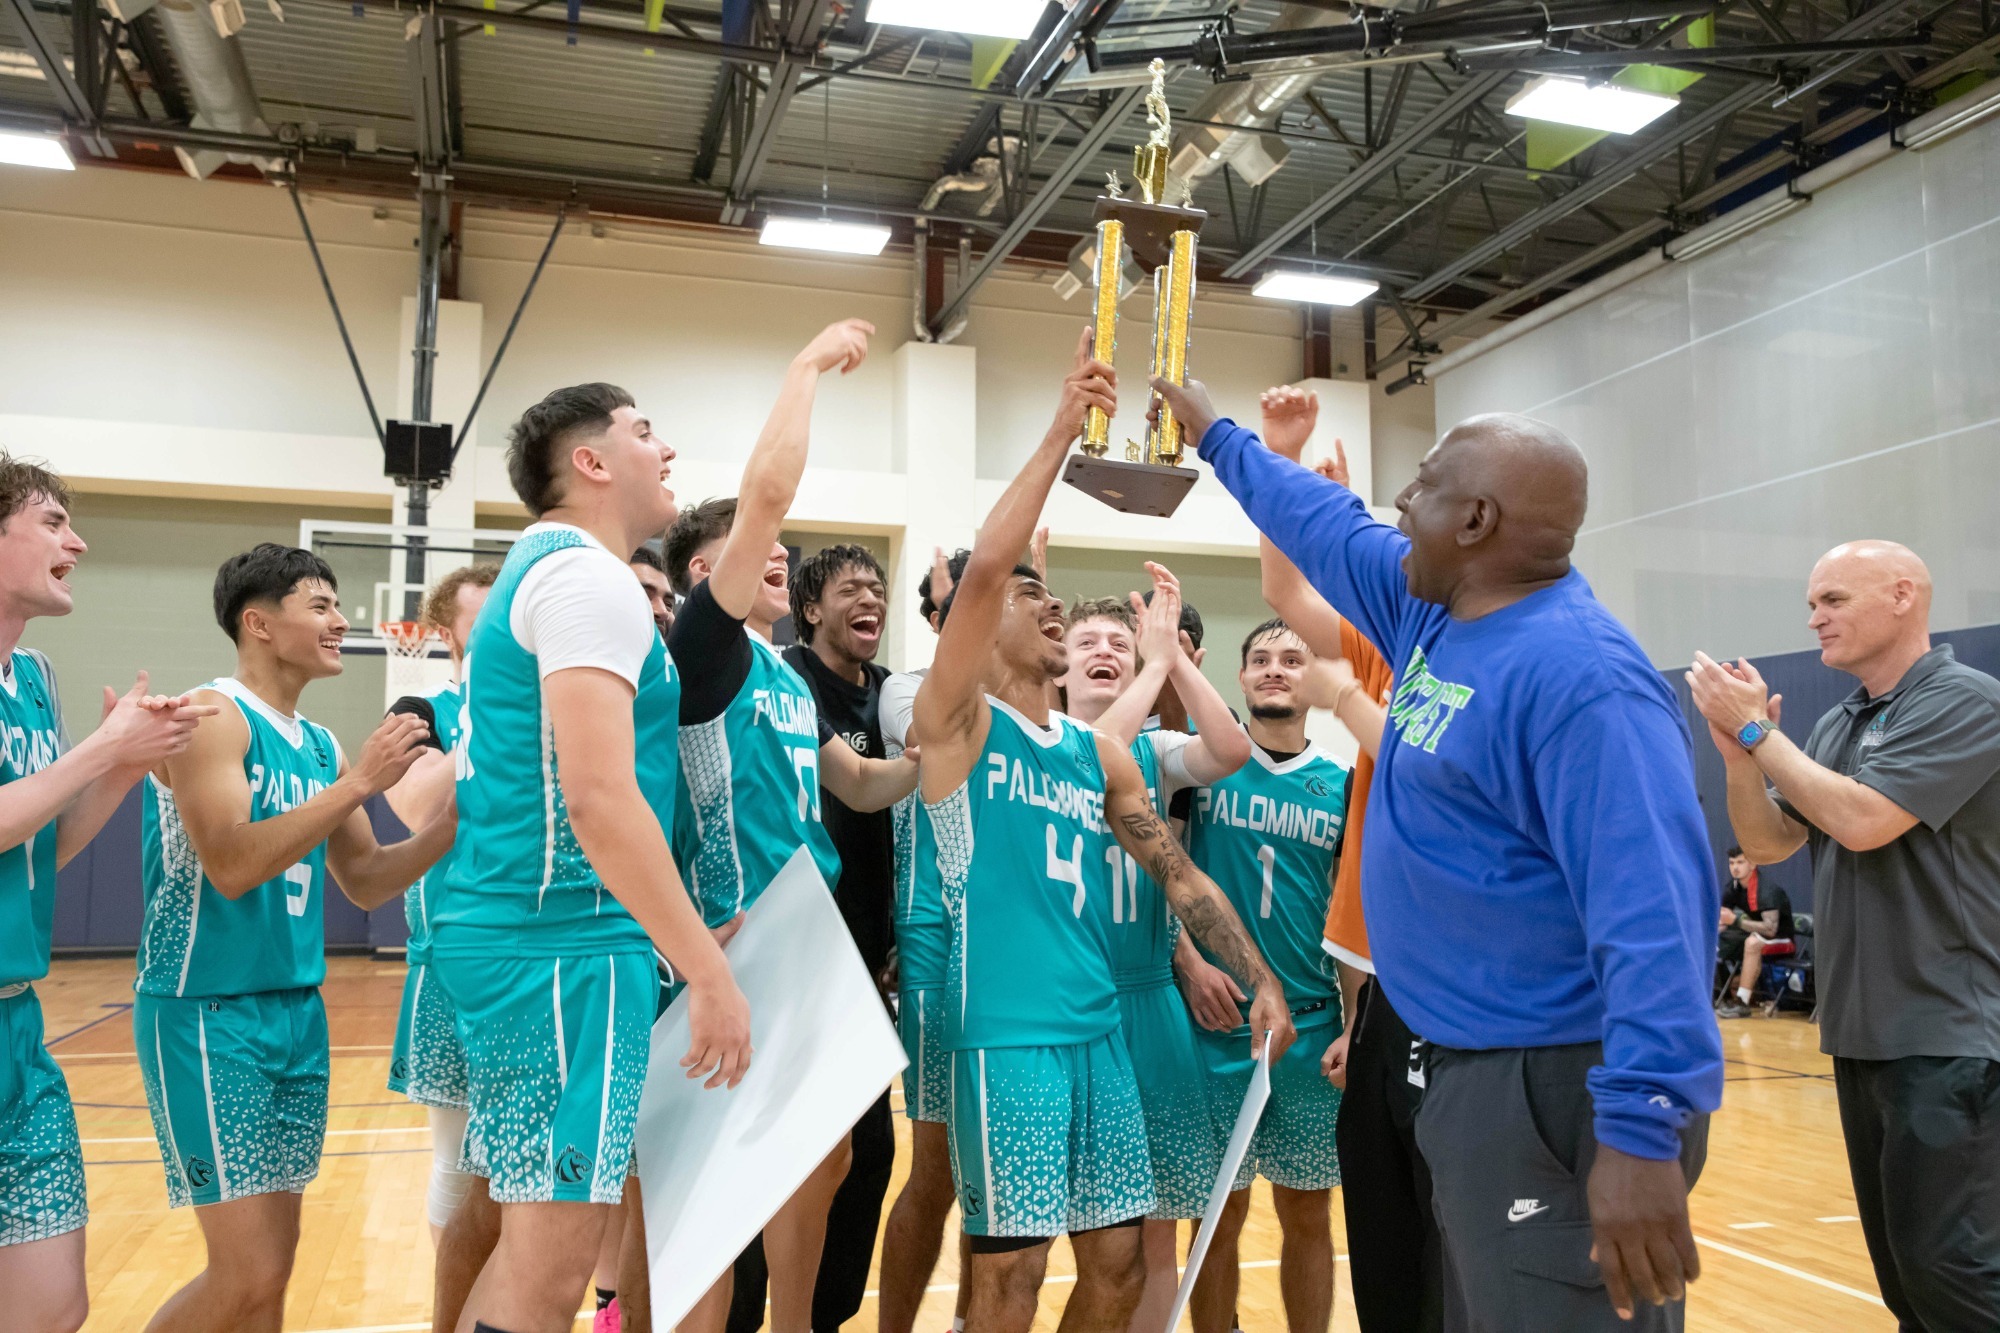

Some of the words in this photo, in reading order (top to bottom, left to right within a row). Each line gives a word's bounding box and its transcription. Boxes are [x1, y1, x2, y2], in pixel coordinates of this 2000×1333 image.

[1197, 788, 1342, 851] PALOMINOS
[1046, 823, 1086, 919] 4
[1257, 844, 1275, 919] 1
[1512, 1199, 1540, 1213] NIKE
